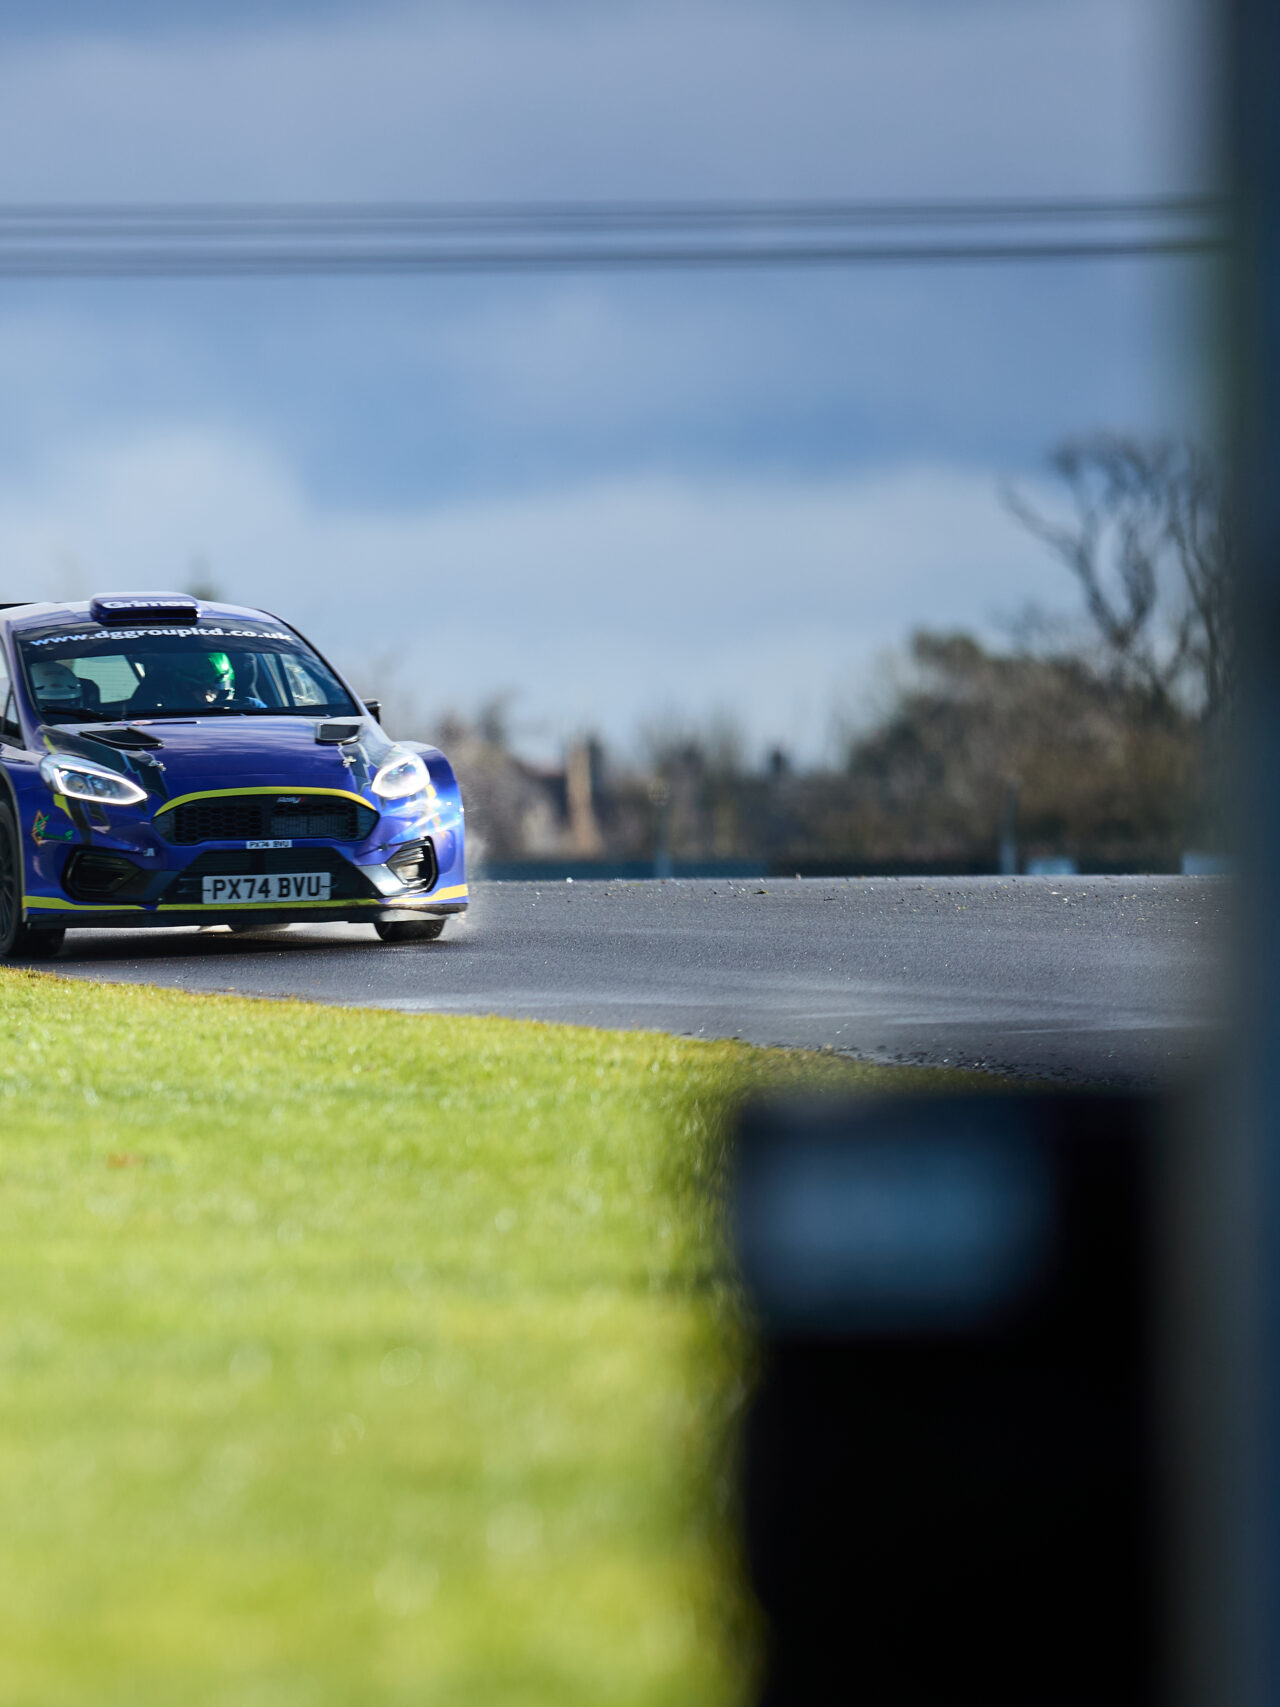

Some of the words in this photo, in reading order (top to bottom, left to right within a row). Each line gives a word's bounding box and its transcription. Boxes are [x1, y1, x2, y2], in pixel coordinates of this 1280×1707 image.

[30, 627, 293, 646] www.dggroupltd.co.uk
[213, 877, 271, 900] PX74
[278, 876, 321, 898] BVU
